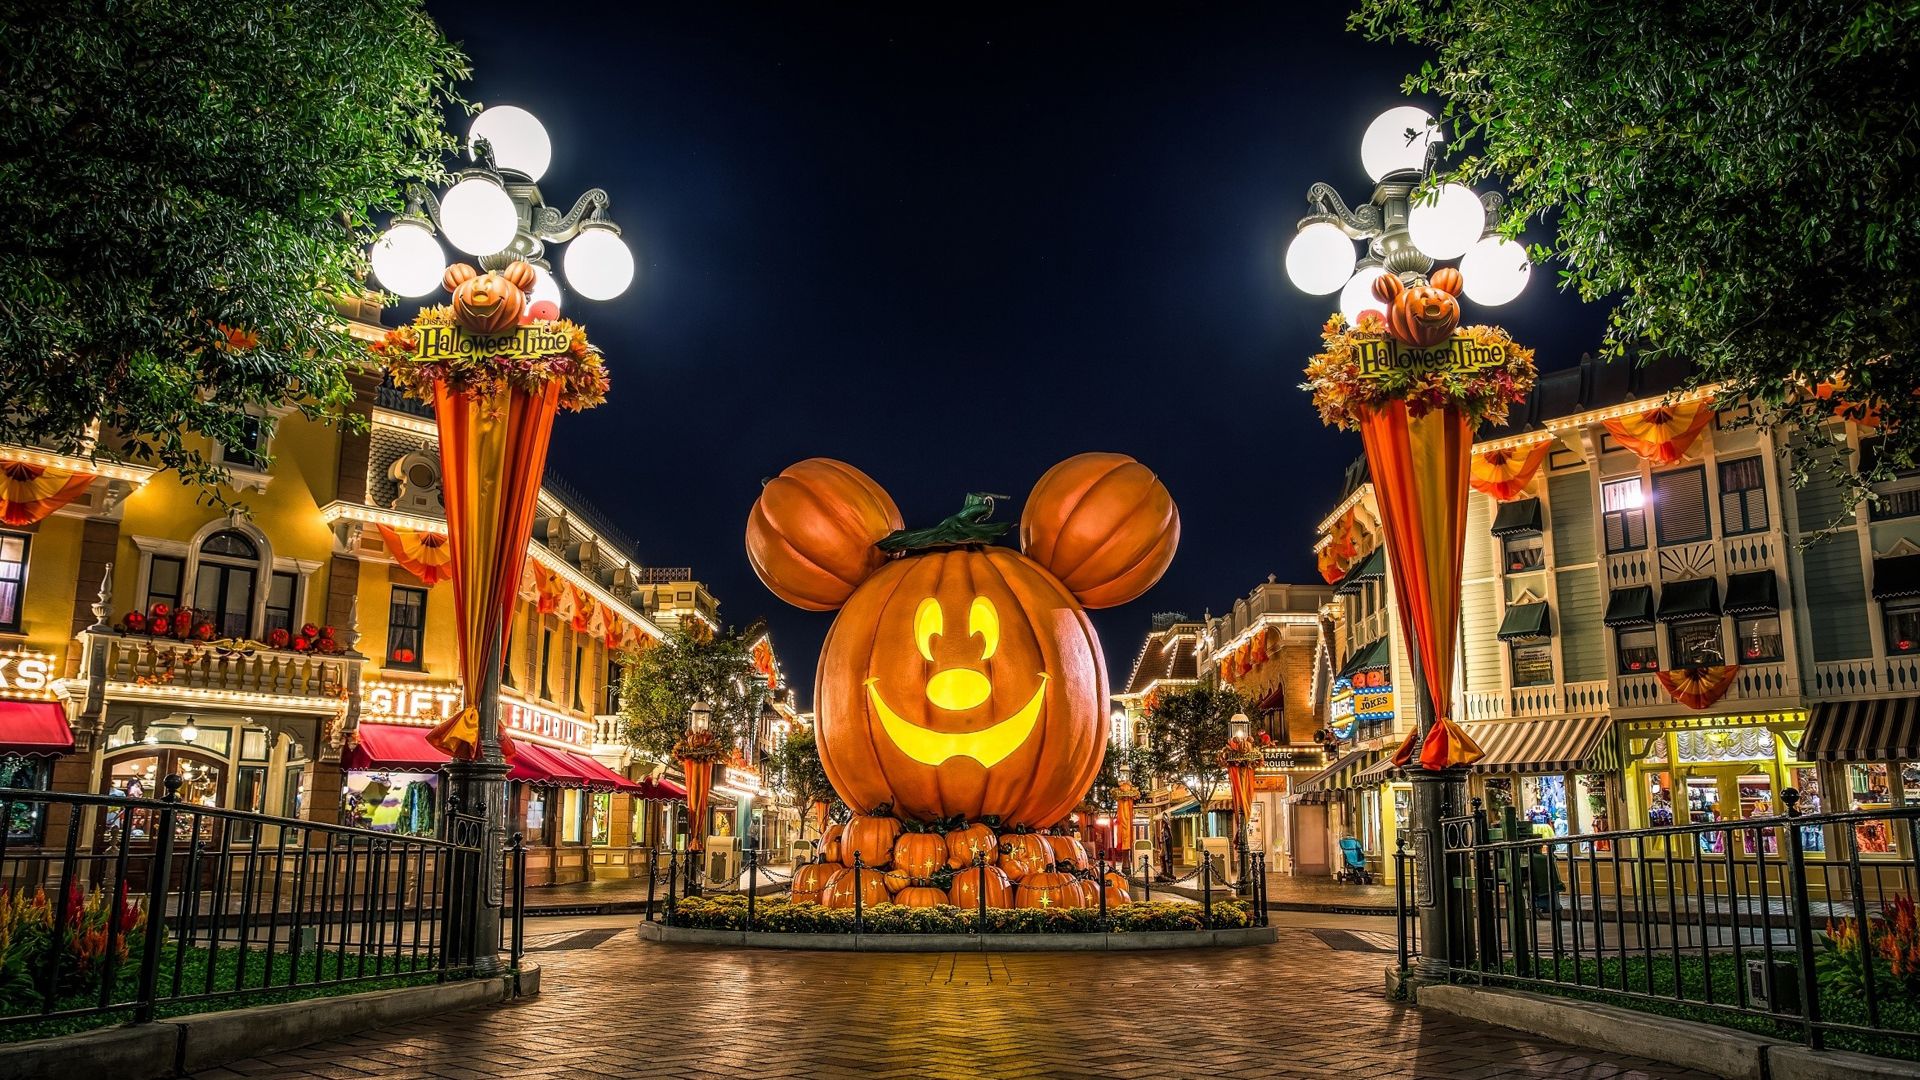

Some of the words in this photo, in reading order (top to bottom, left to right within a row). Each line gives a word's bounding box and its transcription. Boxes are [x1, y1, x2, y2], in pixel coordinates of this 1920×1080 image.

[371, 688, 457, 718] GIFT
[1361, 697, 1388, 710] JOKES
[512, 704, 586, 745] EMPORIUM
